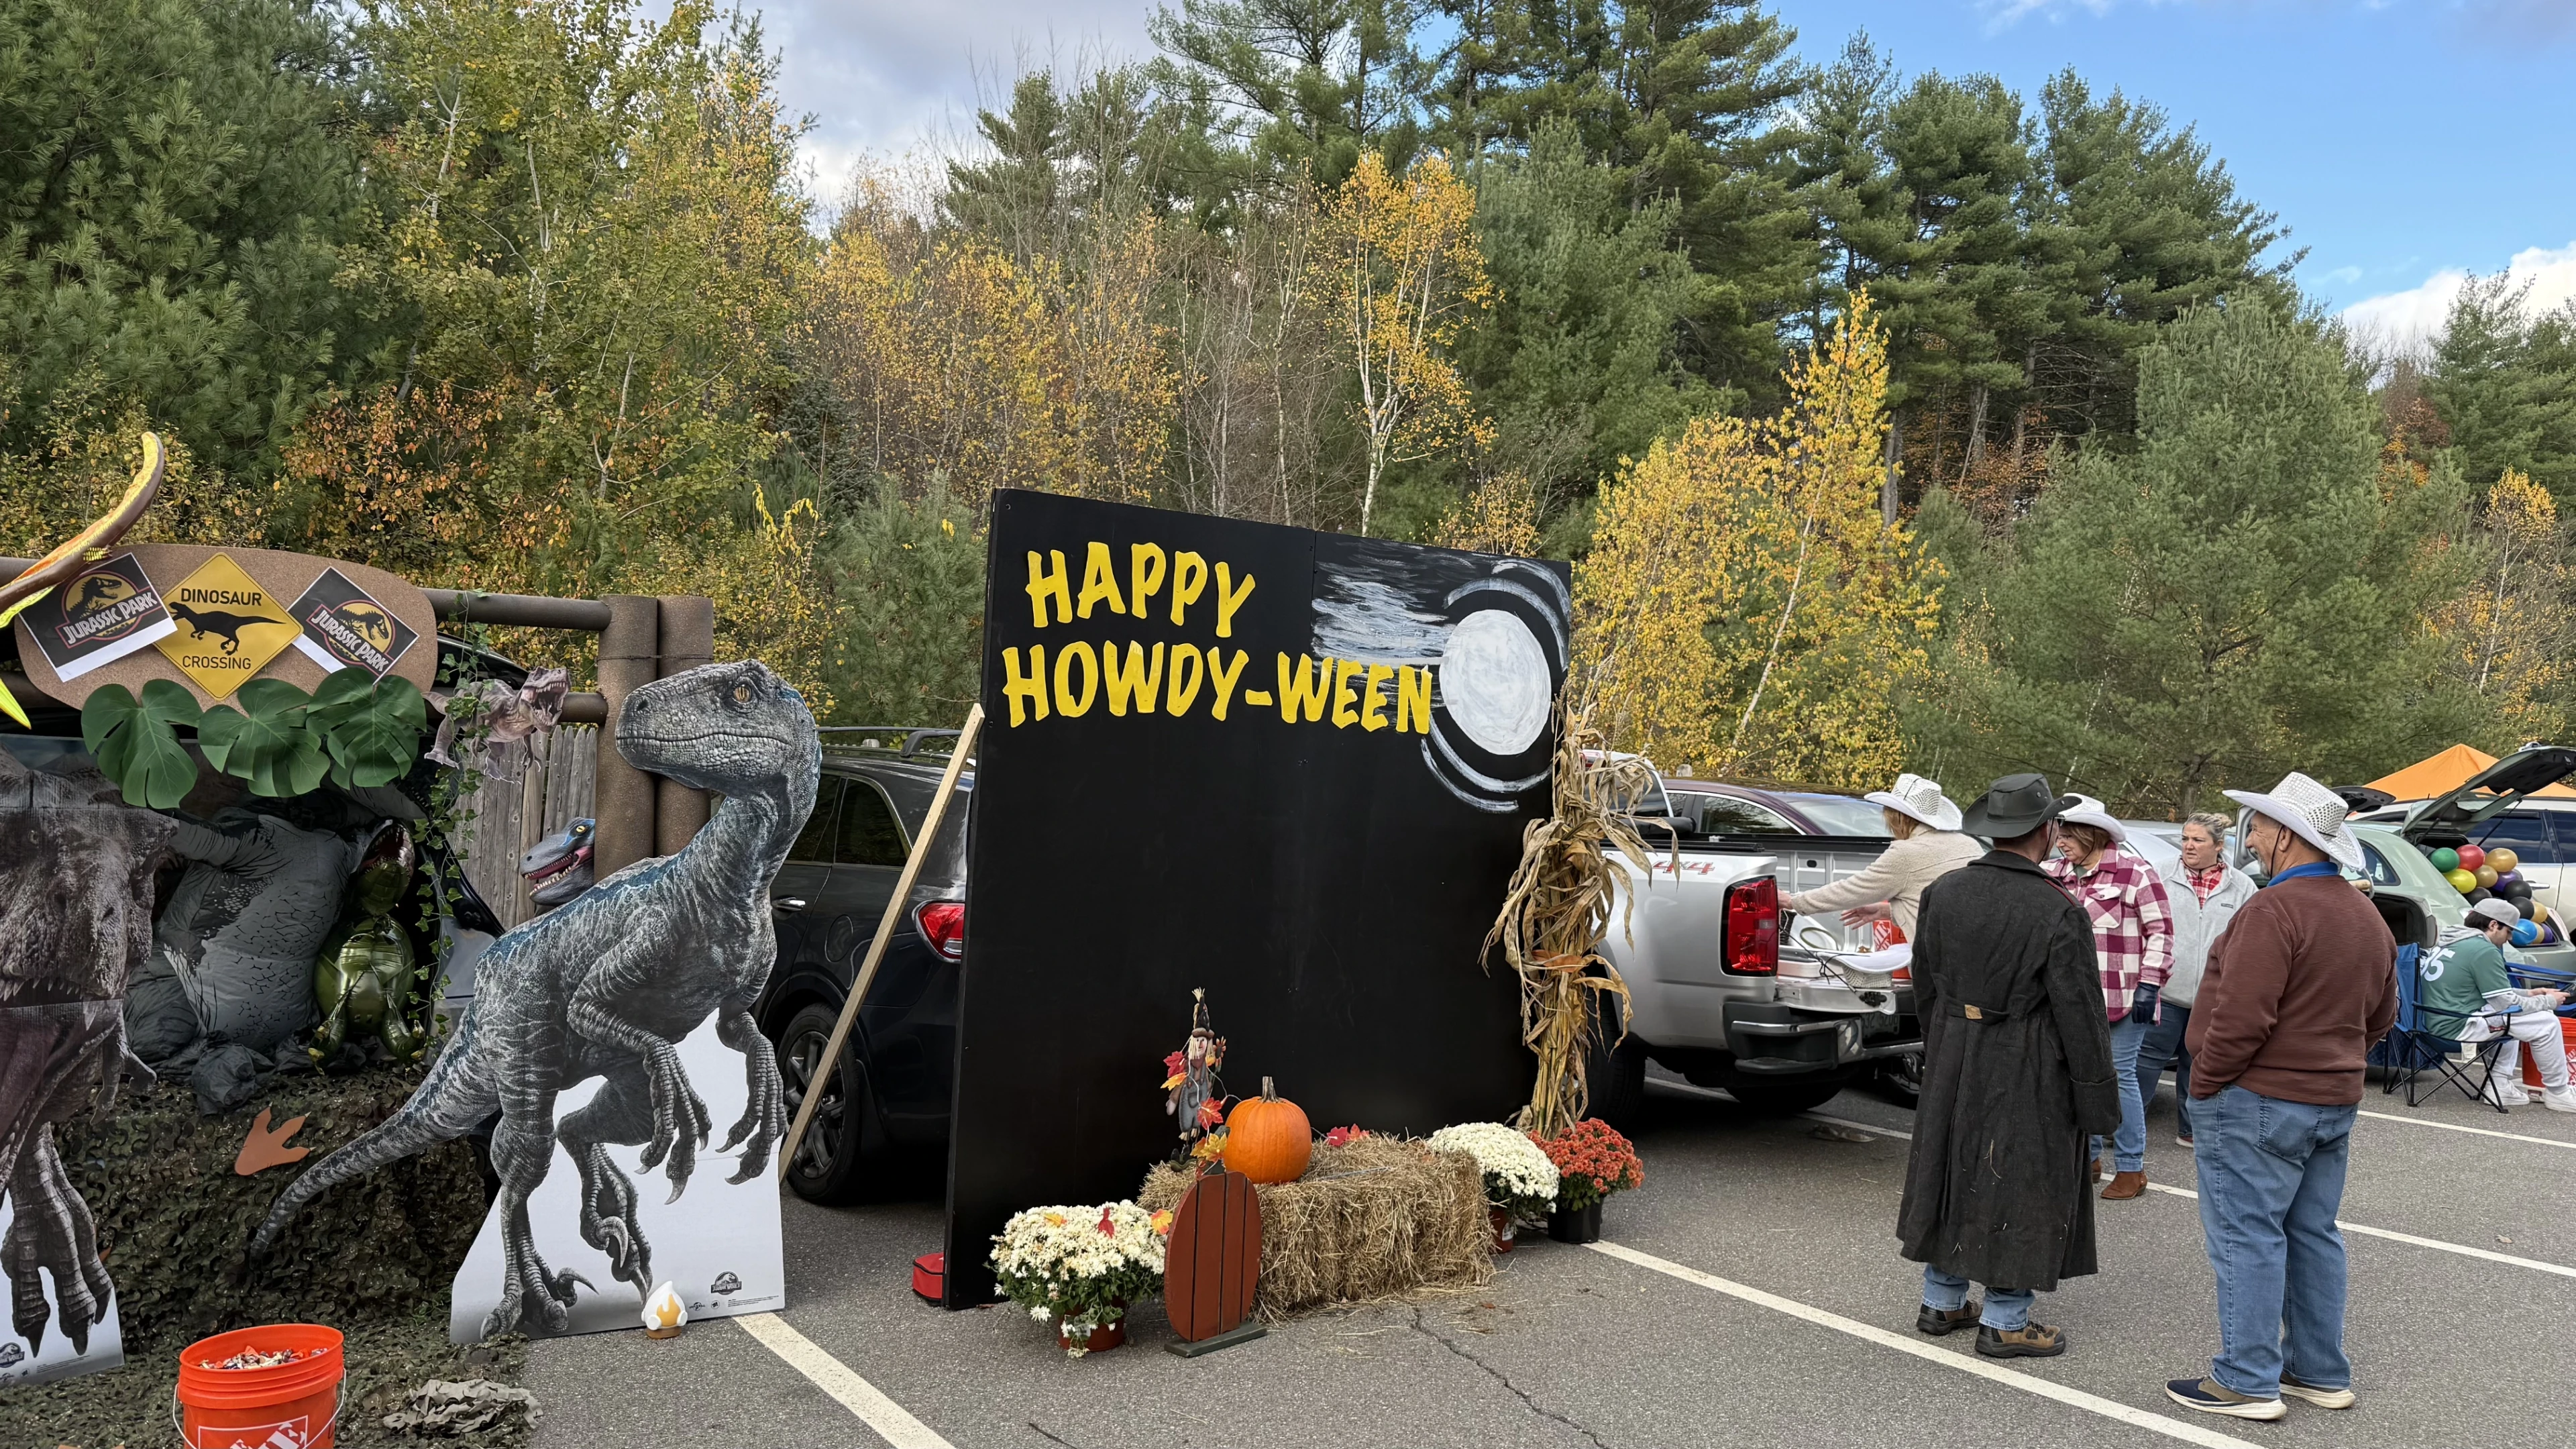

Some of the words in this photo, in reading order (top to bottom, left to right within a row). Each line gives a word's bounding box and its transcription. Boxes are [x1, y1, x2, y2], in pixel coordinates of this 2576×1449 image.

[63, 608, 121, 644] JURASSIC
[117, 592, 158, 619] PARK
[181, 588, 262, 606] DINOSAUR
[1026, 541, 1256, 638] HAPPY
[182, 655, 251, 669] CROSSING
[311, 609, 361, 651] JURASSIC
[355, 641, 389, 672] PARK
[1002, 641, 1432, 734] HOWDY-WEEN
